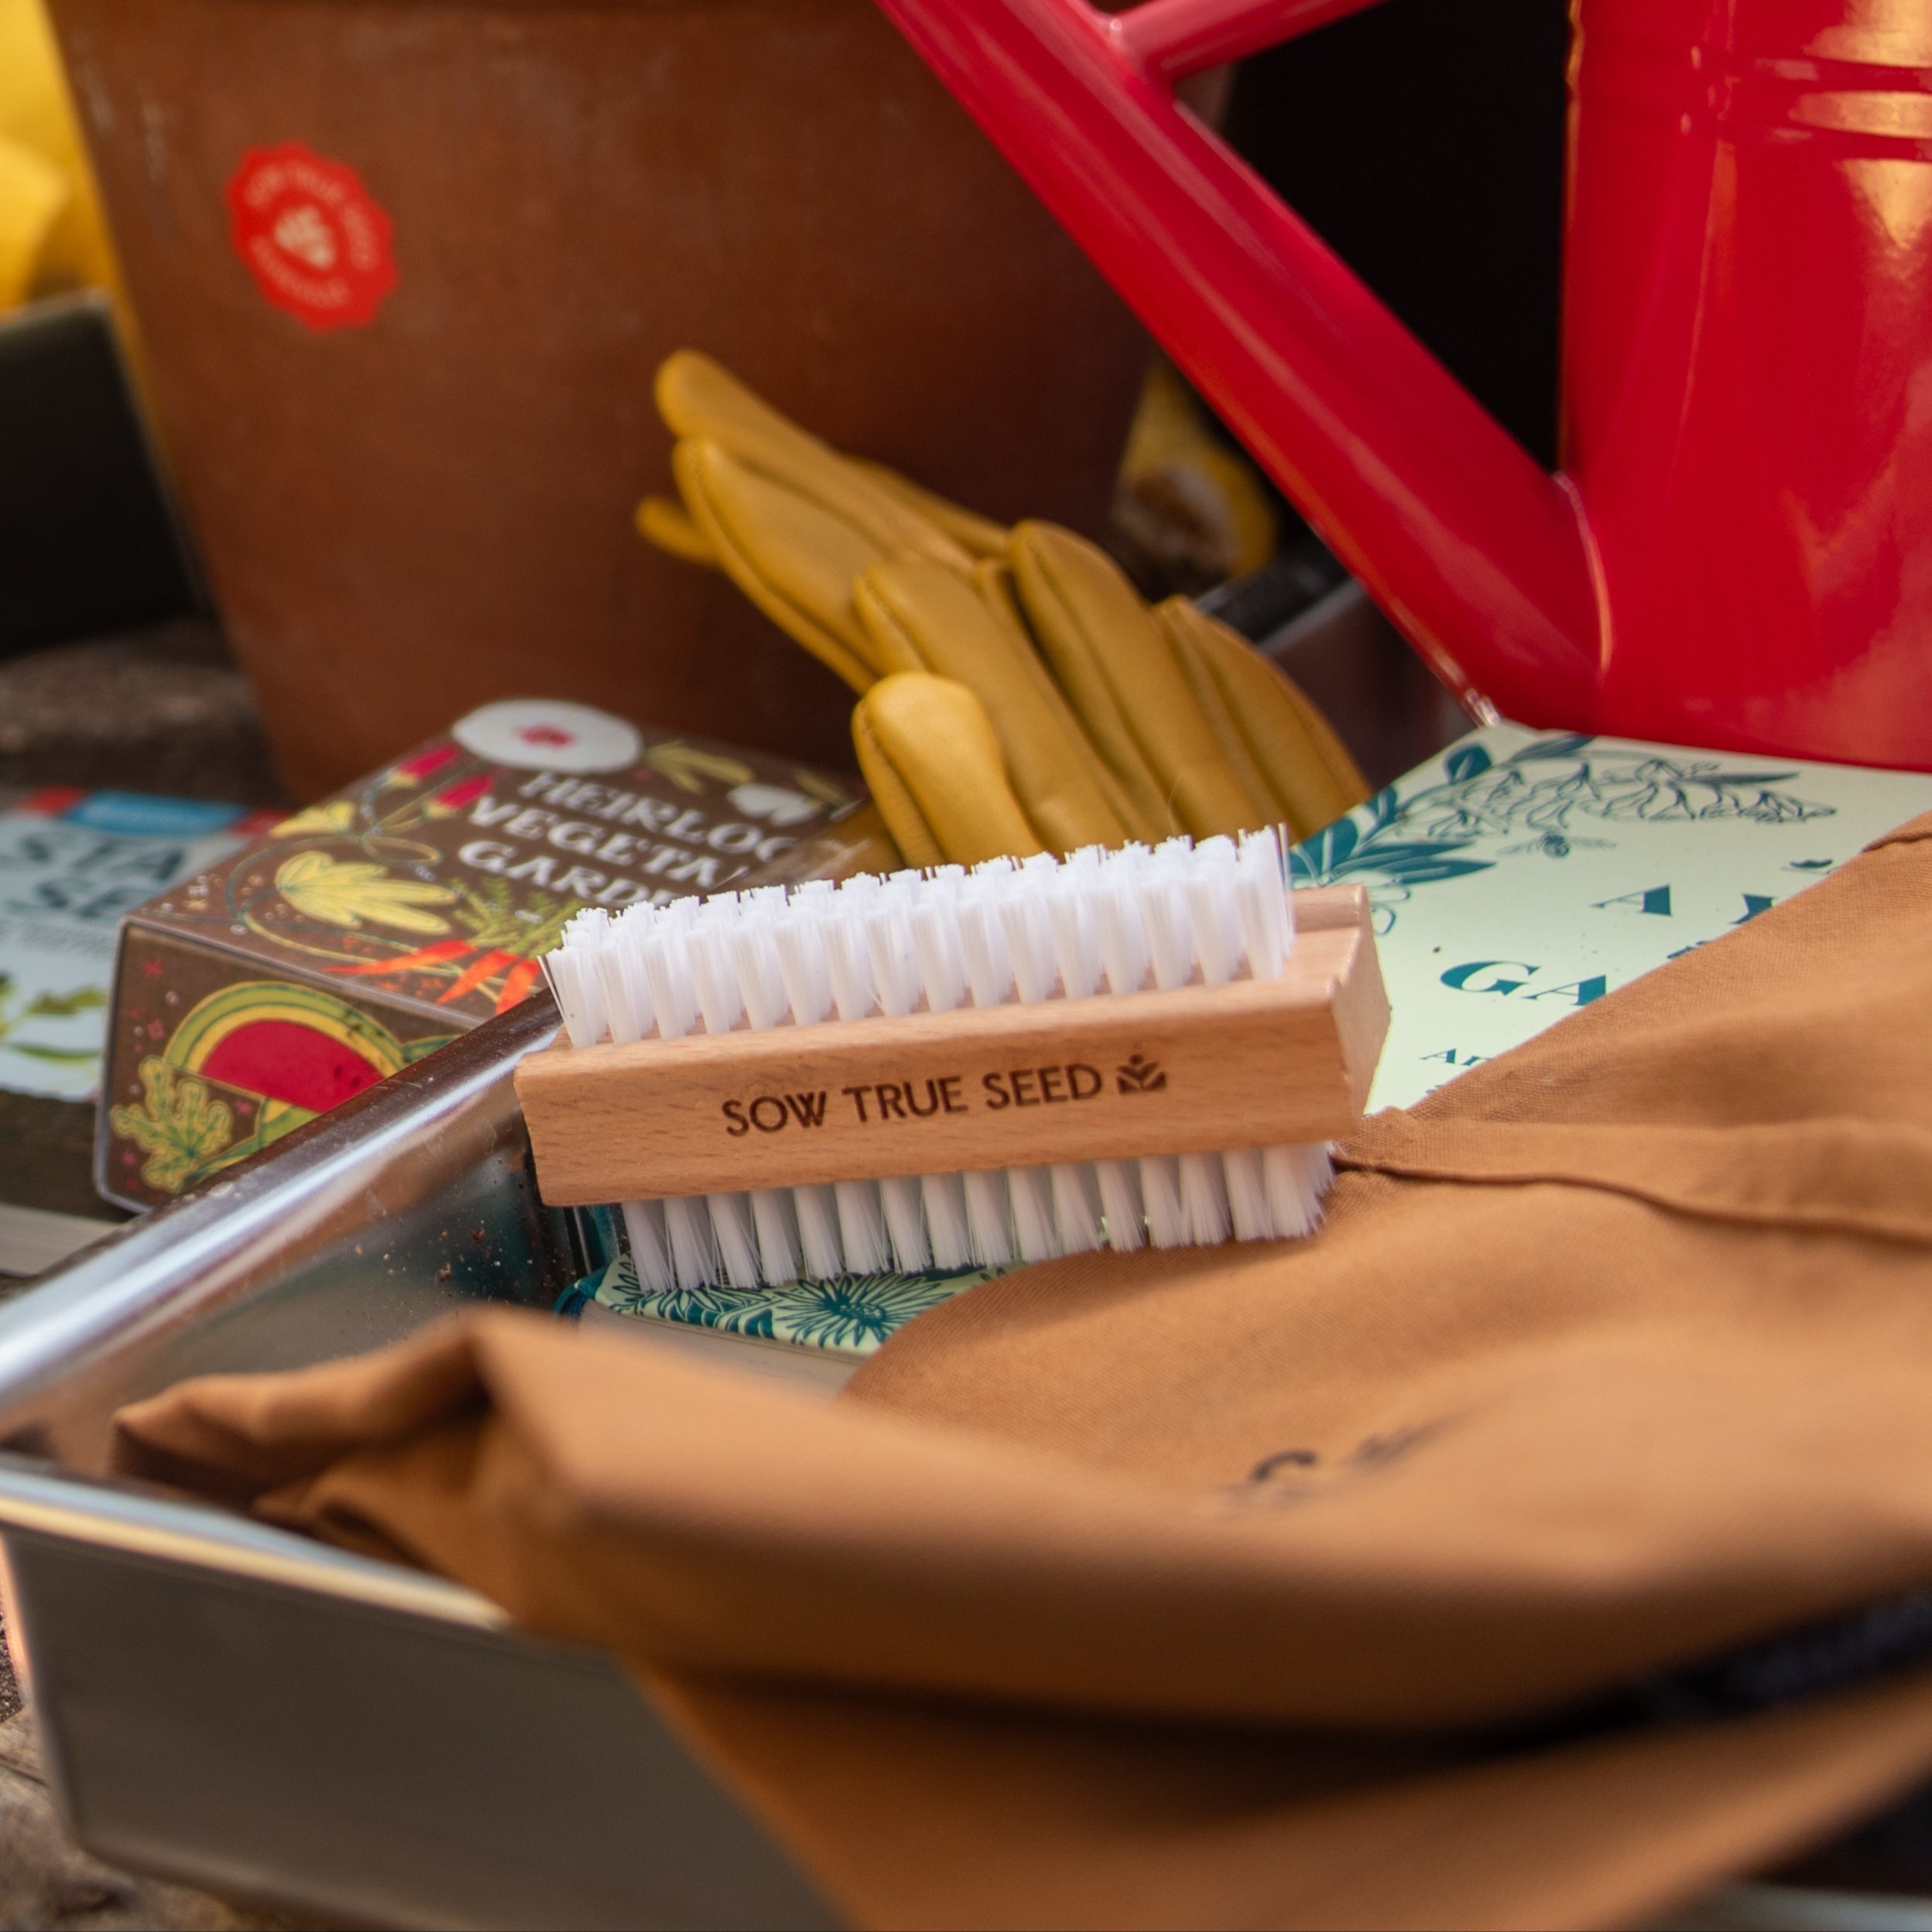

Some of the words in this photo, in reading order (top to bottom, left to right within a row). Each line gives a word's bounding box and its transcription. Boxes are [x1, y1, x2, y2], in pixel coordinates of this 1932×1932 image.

[1440, 961, 1606, 1006] GA
[721, 1091, 827, 1137] SOW
[841, 1076, 969, 1123] TRUE
[982, 1064, 1102, 1110] SEED
